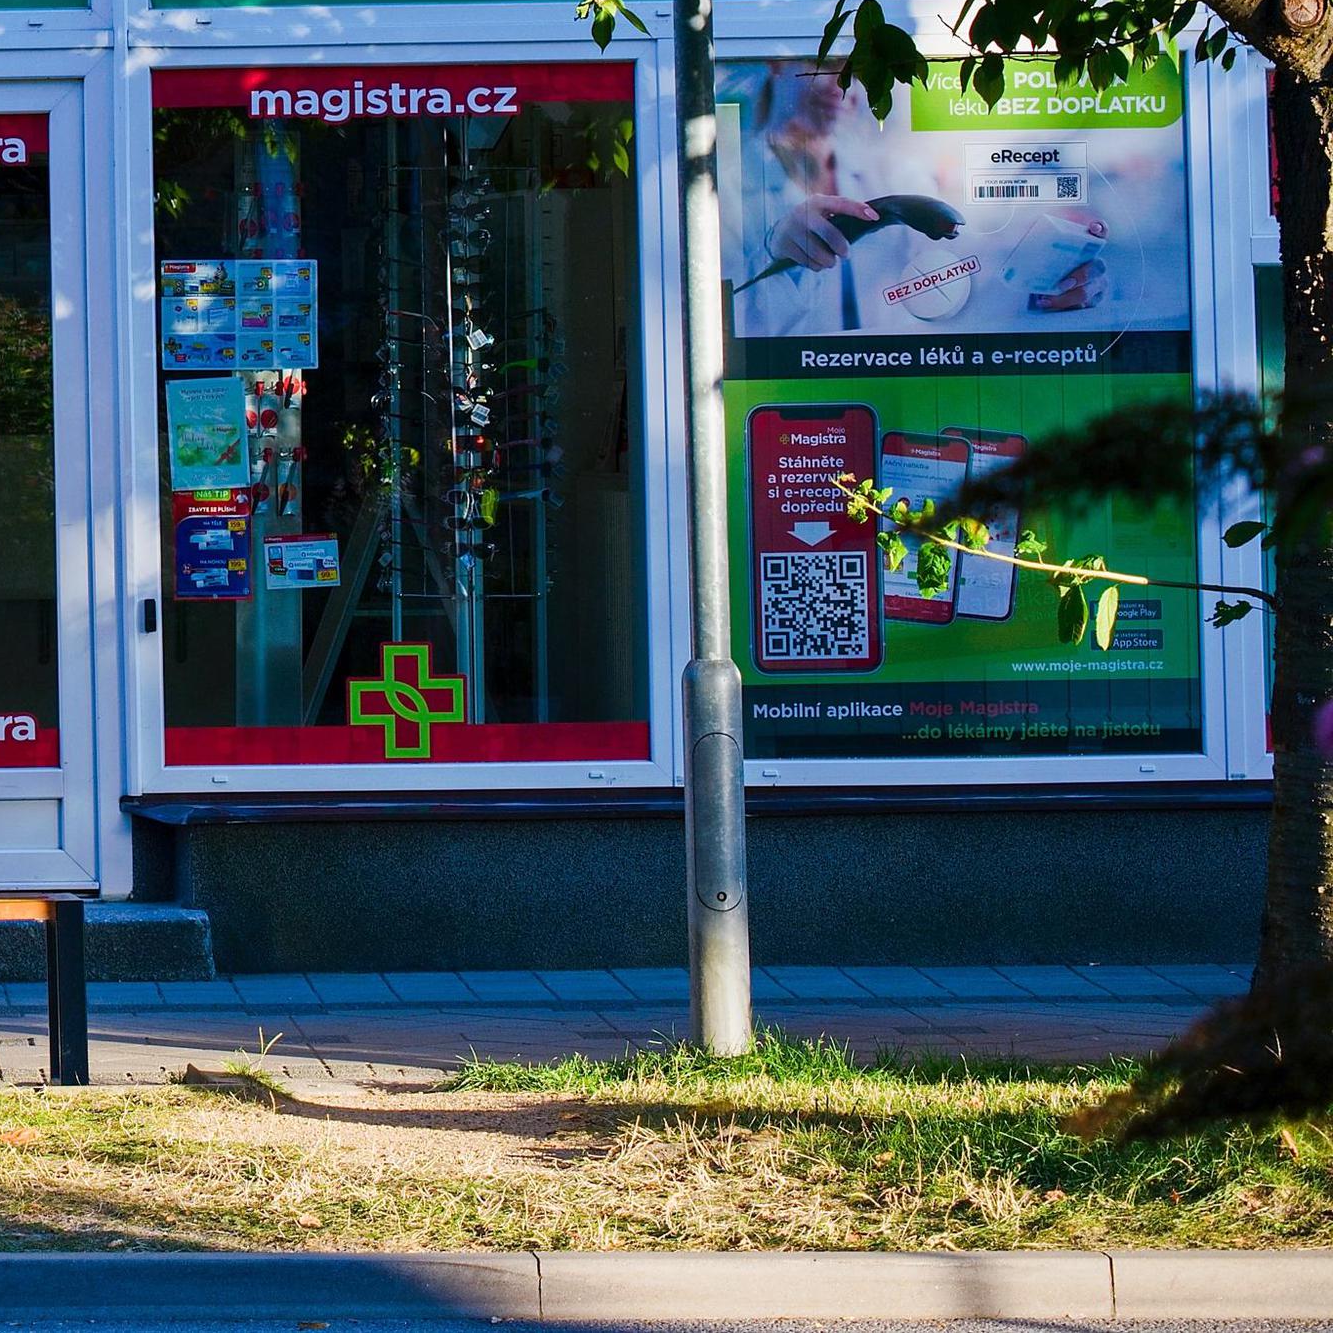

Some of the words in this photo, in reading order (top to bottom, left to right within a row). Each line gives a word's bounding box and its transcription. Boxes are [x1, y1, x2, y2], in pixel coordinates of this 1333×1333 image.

[250, 79, 518, 120] magistra.cz
[997, 97, 1040, 115] BEZ
[1047, 95, 1166, 114] DOPLATKU
[991, 149, 1060, 165] eRecept
[887, 281, 910, 302] BEZ
[912, 259, 978, 293] DOPLATKU
[801, 347, 912, 367] Rezervace
[920, 345, 964, 364] léků
[972, 351, 984, 364] a
[991, 342, 1097, 367] e-receptů
[791, 433, 846, 446] Magistra
[779, 455, 844, 468] Stáhněte
[768, 474, 776, 483] a
[768, 485, 779, 498] si
[781, 500, 844, 515] dopředu
[1117, 608, 1139, 618] oogle
[1140, 608, 1156, 618] Play
[1113, 638, 1132, 648] App
[1133, 637, 1158, 647] Store
[1011, 658, 1164, 673] www.moje-magistra.cz
[753, 701, 820, 718] Mobilní
[826, 701, 903, 720] aplikace
[909, 701, 953, 719] Moje
[960, 699, 1040, 718] Magistra
[901, 722, 942, 739] ...do
[948, 722, 1015, 742] lékárny
[1021, 720, 1069, 741] jděte
[1075, 726, 1098, 737] na
[1102, 720, 1161, 739] jistotu
